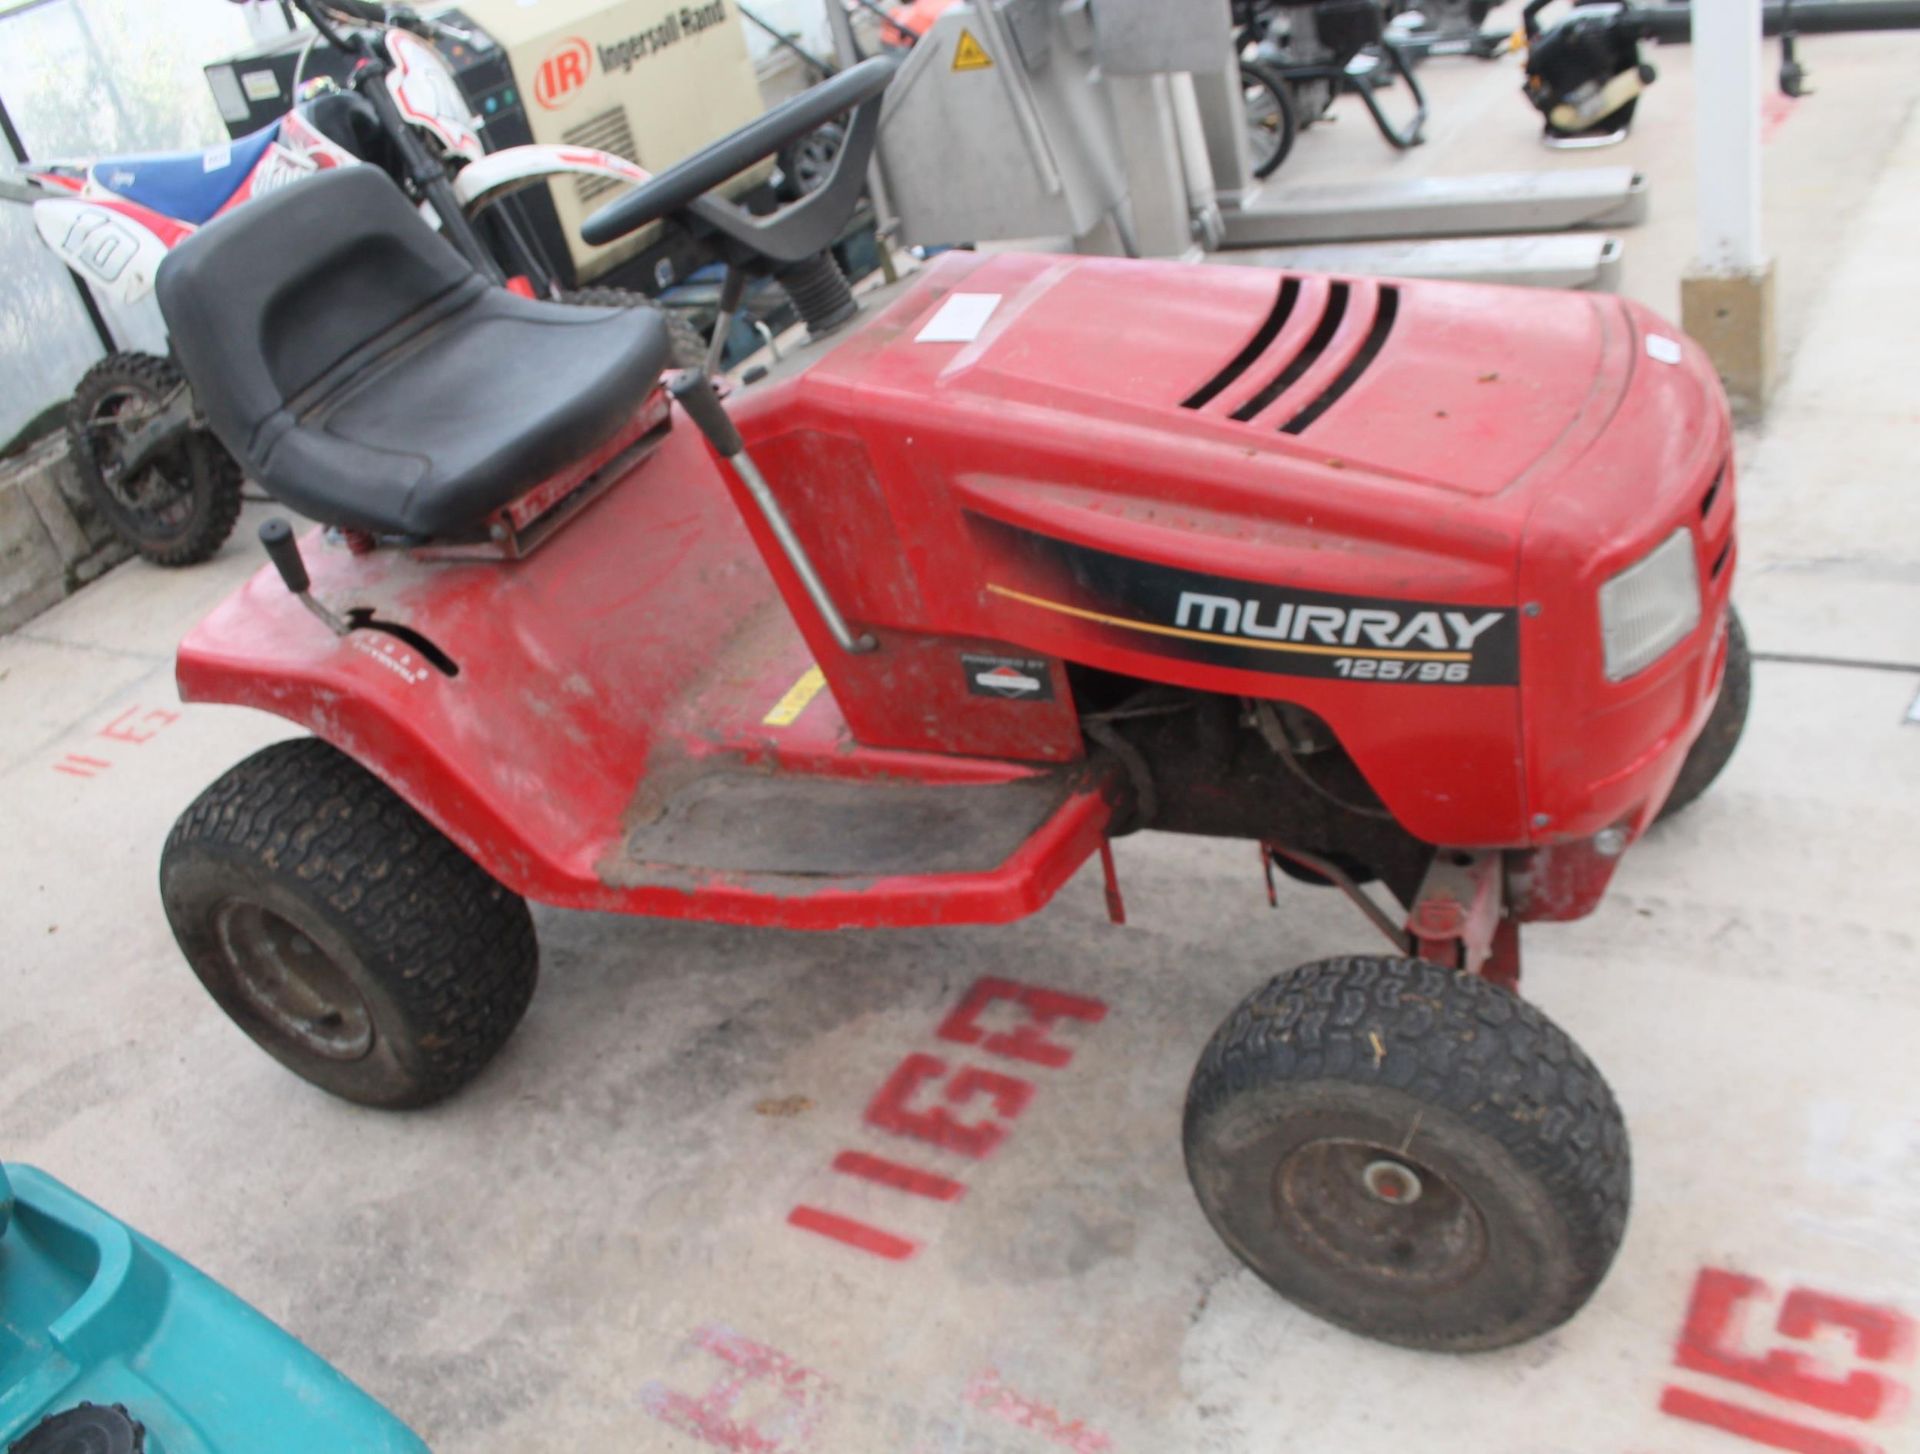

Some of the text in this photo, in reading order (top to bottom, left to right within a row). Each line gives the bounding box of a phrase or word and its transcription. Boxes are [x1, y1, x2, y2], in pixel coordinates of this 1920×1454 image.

[542, 49, 584, 99] IR
[596, 13, 680, 74] Ingersoll
[1175, 591, 1505, 650] MURRAY
[1333, 657, 1471, 683] 125/96
